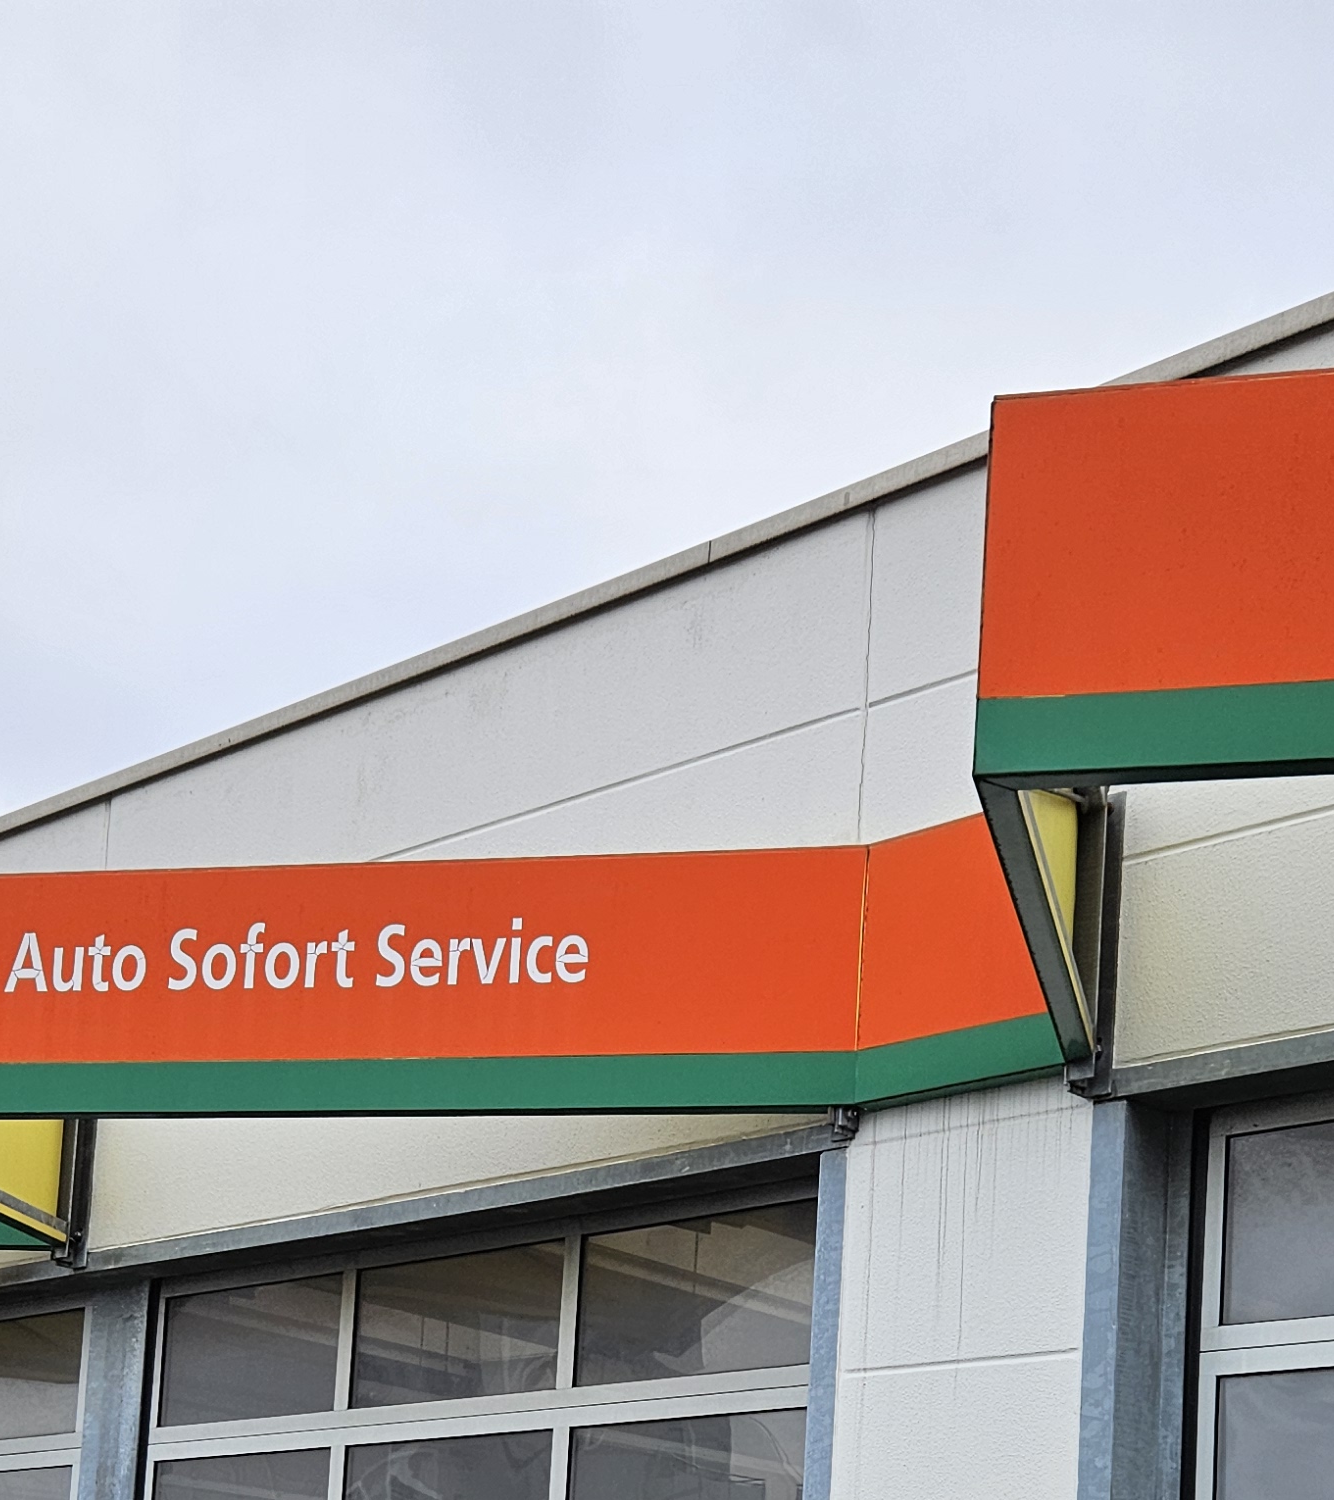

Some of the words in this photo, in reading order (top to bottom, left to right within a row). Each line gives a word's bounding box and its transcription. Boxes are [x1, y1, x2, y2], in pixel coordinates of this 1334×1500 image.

[3, 932, 147, 993] Auto
[167, 922, 356, 991] Sofort
[375, 917, 589, 988] Service
